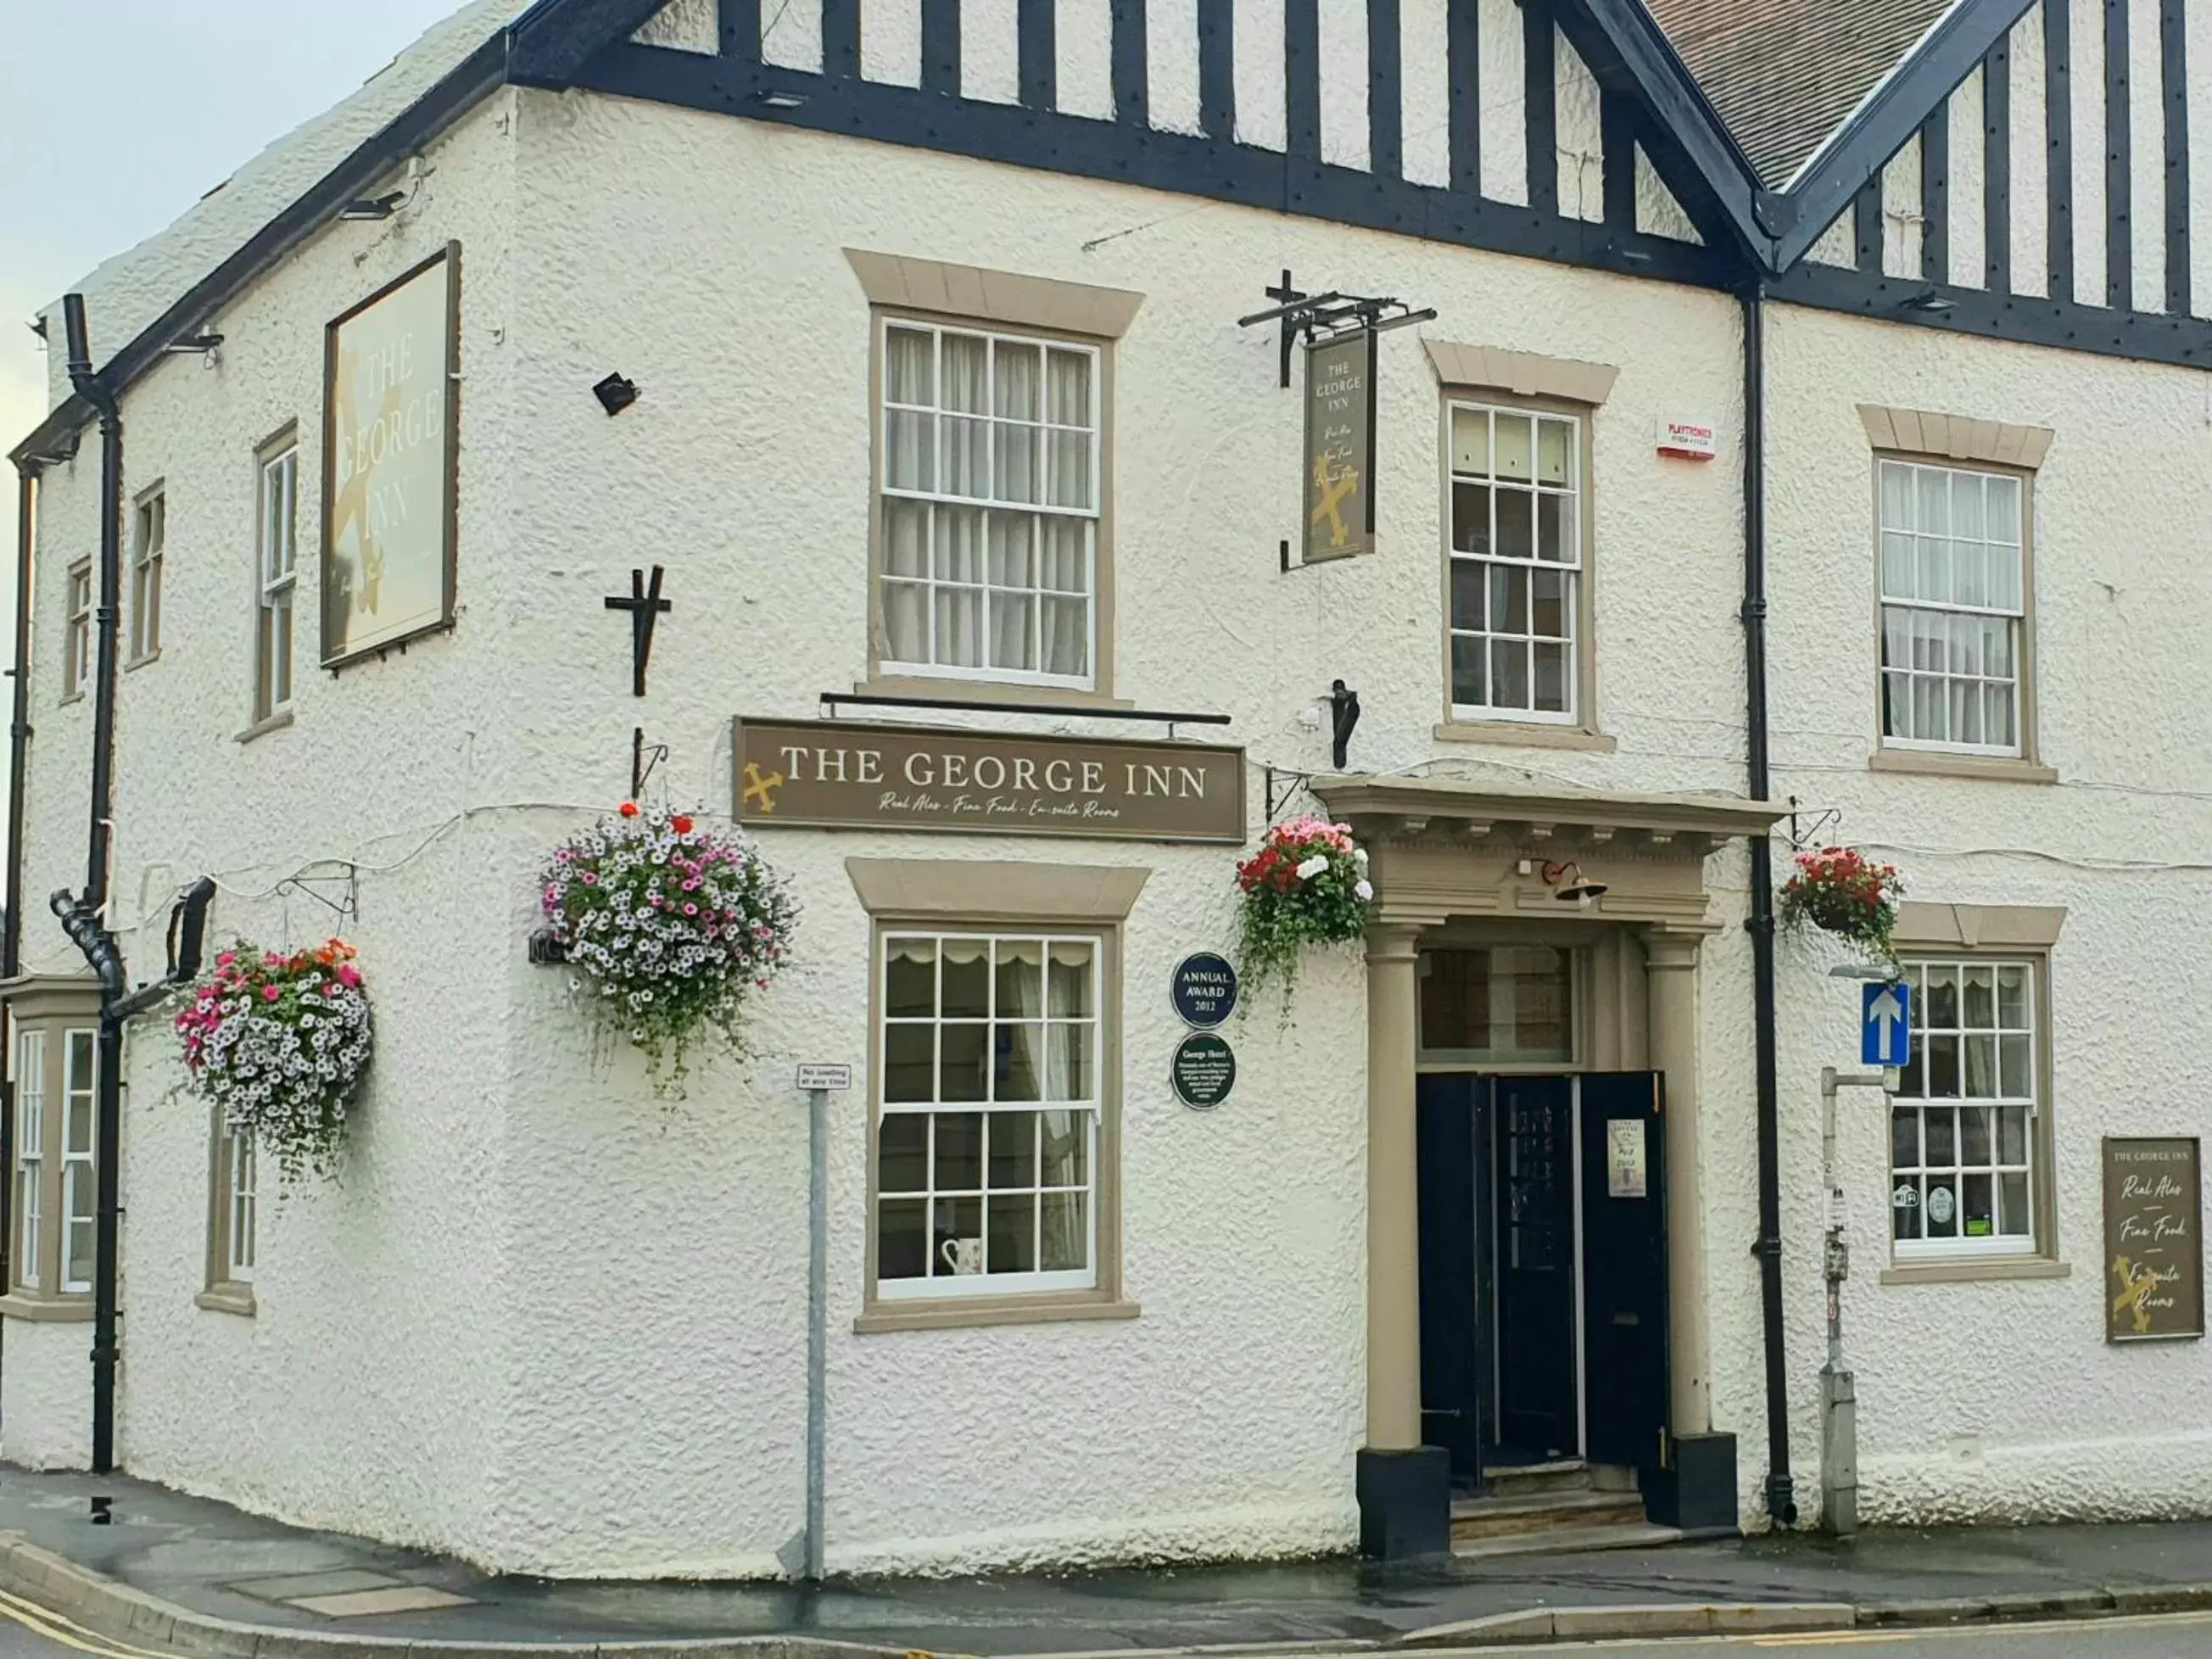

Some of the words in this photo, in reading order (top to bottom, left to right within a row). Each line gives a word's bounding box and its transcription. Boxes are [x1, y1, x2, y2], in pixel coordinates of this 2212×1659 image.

[366, 332, 413, 399] THE
[1328, 361, 1349, 377] THE
[1316, 377, 1360, 398] GEORGE
[1328, 397, 1349, 412] INN
[338, 388, 440, 482] GEORGE
[364, 477, 410, 539] INN
[781, 746, 884, 785] THE
[904, 751, 1106, 796] GEORGE
[1126, 764, 1208, 799] INN
[879, 791, 910, 811] Real
[952, 794, 981, 813] Fine
[986, 796, 1018, 815] Food
[1081, 800, 1120, 818] Rooms
[1182, 972, 1230, 984] ANNUAL
[1186, 986, 1226, 997] AWARD
[1194, 1001, 1216, 1012] 2012
[2114, 1152, 2131, 1161] THE
[2133, 1152, 2169, 1161] GEORGE
[2171, 1152, 2189, 1161] INN
[2121, 1174, 2152, 1200] Real
[2153, 1175, 2182, 1198] Ales
[2120, 1215, 2150, 1242] Fine
[2154, 1215, 2187, 1242] Food
[2134, 1290, 2175, 1311] Rooms
